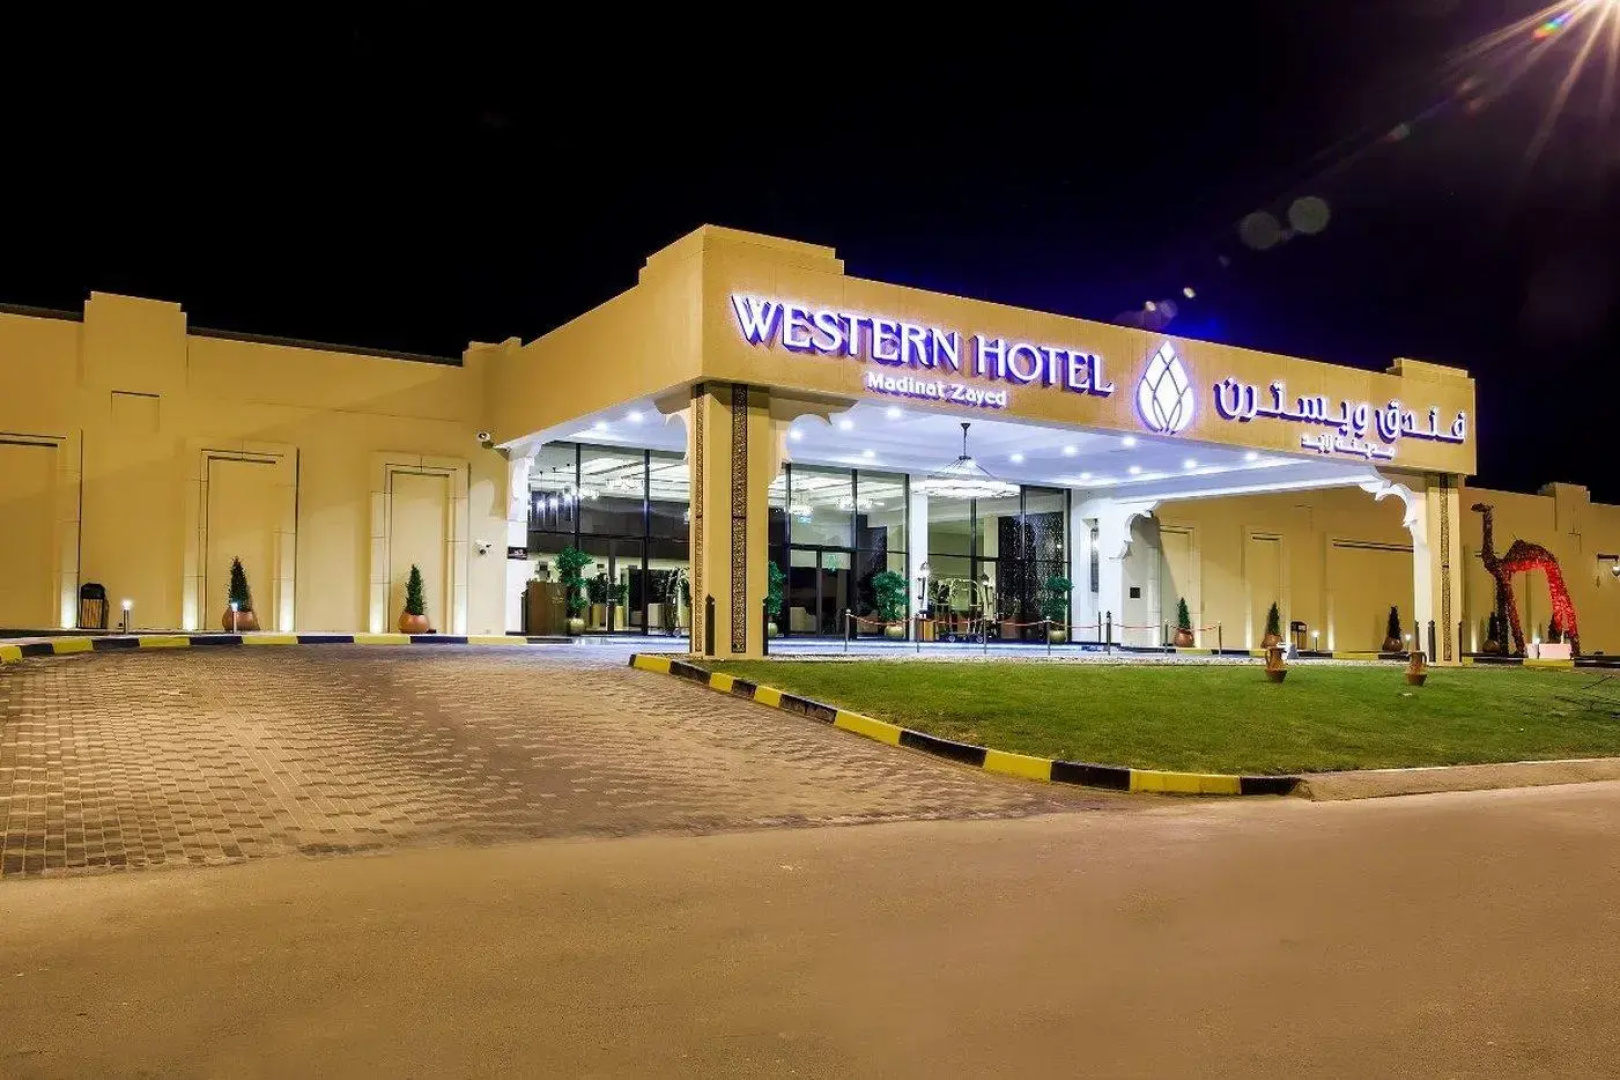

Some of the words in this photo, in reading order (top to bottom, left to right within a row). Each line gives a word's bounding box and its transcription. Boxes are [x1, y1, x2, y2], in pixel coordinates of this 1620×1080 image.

[732, 294, 959, 370] WESTERN
[976, 335, 1114, 393] HOTEL
[866, 371, 945, 397] Madinat
[947, 382, 1007, 407] Zayed
[1213, 377, 1371, 438] ويسترن
[1374, 400, 1467, 444] فندق
